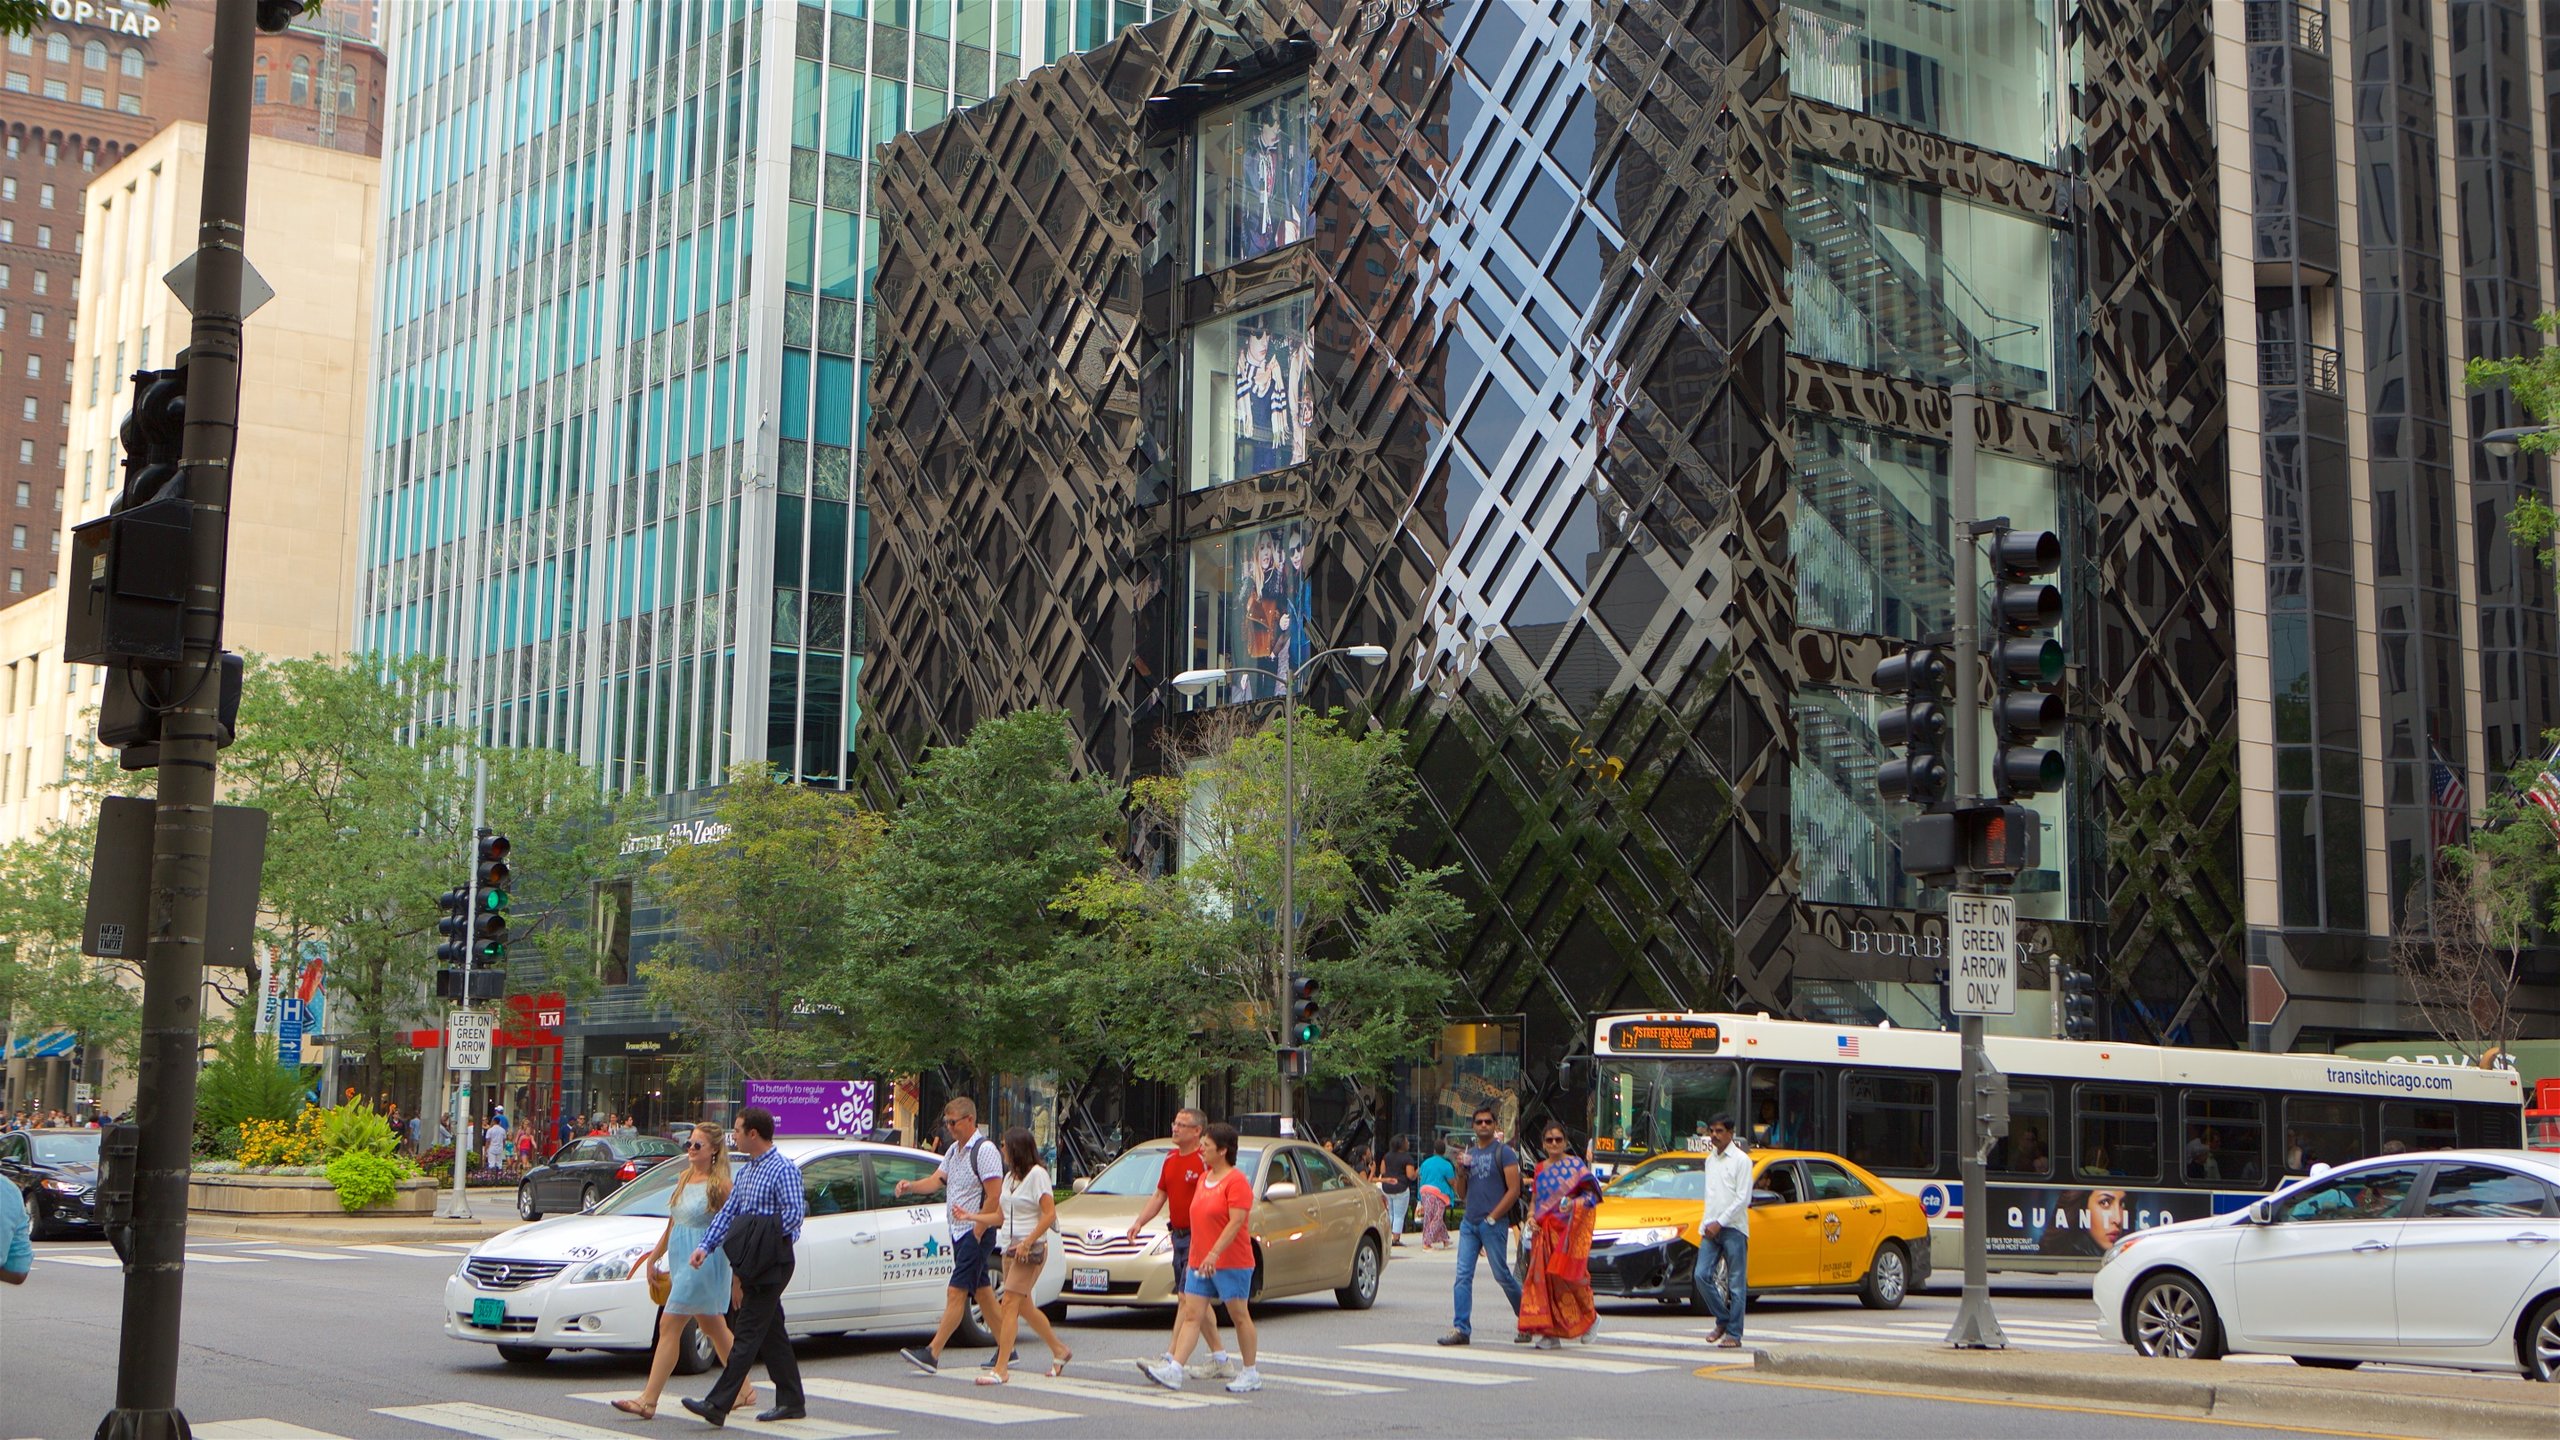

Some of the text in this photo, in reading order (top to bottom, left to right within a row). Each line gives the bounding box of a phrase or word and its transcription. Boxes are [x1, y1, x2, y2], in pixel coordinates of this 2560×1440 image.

[105, 6, 161, 39] TAP
[1954, 902, 2010, 926] LEFT ON
[1850, 930, 2034, 965] BURBY
[1962, 929, 2004, 952] GREEN
[1960, 956, 2007, 979] ARROW
[1967, 982, 2000, 1005] ONLY
[453, 1015, 490, 1027] LEFT ON
[456, 1028, 486, 1039] GREEN
[454, 1040, 486, 1052] ARROW
[458, 1053, 481, 1065] ONLY
[2327, 1067, 2452, 1092] transitchicago.com
[752, 1084, 825, 1096] The butterfly to regular
[751, 1095, 821, 1105] shopping's caterpillar.
[1923, 1195, 1941, 1207] cta
[907, 1208, 933, 1225] 3459
[2008, 1206, 2174, 1230] QUANTICO
[883, 1250, 895, 1262] 5
[883, 1259, 953, 1270] TAXI ASSOCIATION
